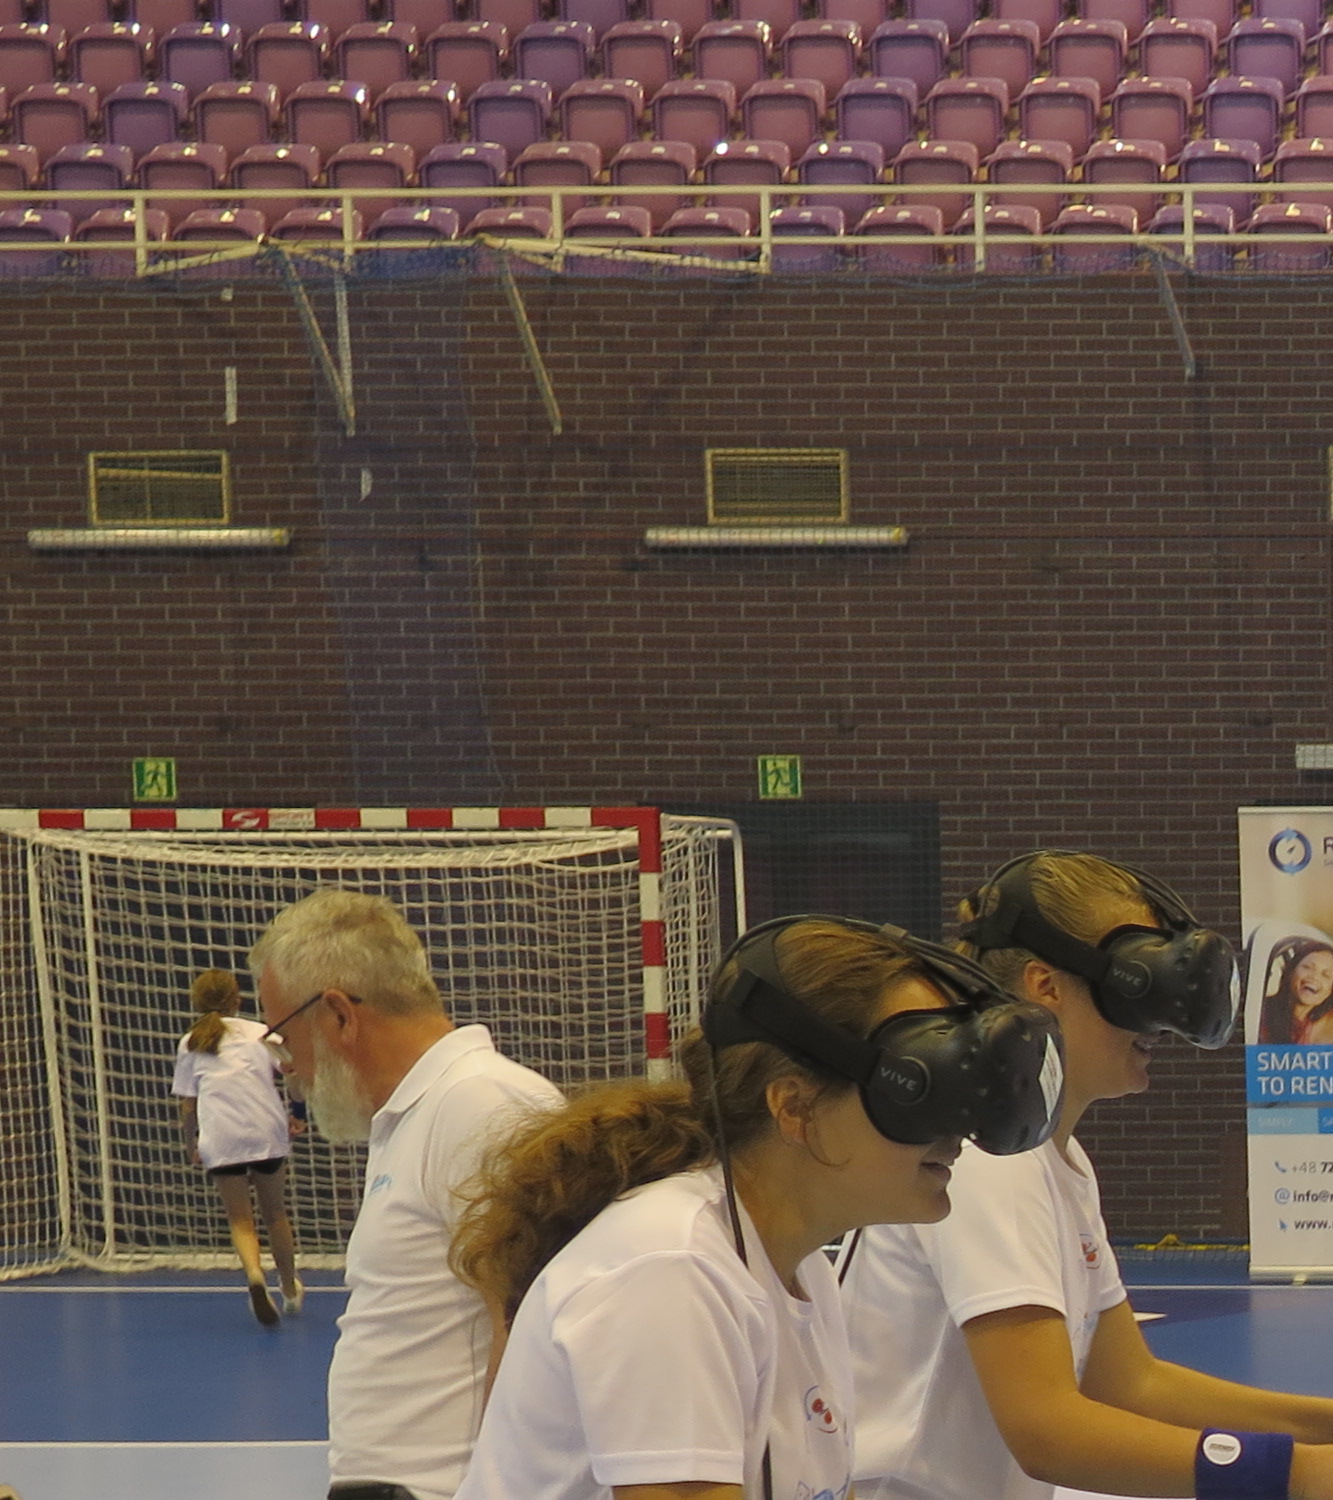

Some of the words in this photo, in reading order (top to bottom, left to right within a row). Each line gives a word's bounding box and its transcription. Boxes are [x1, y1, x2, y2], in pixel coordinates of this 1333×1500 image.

[1112, 967, 1143, 987] VIVE
[1257, 1051, 1333, 1072] SMART
[880, 1066, 918, 1092] VIVE
[1257, 1076, 1285, 1096] TO
